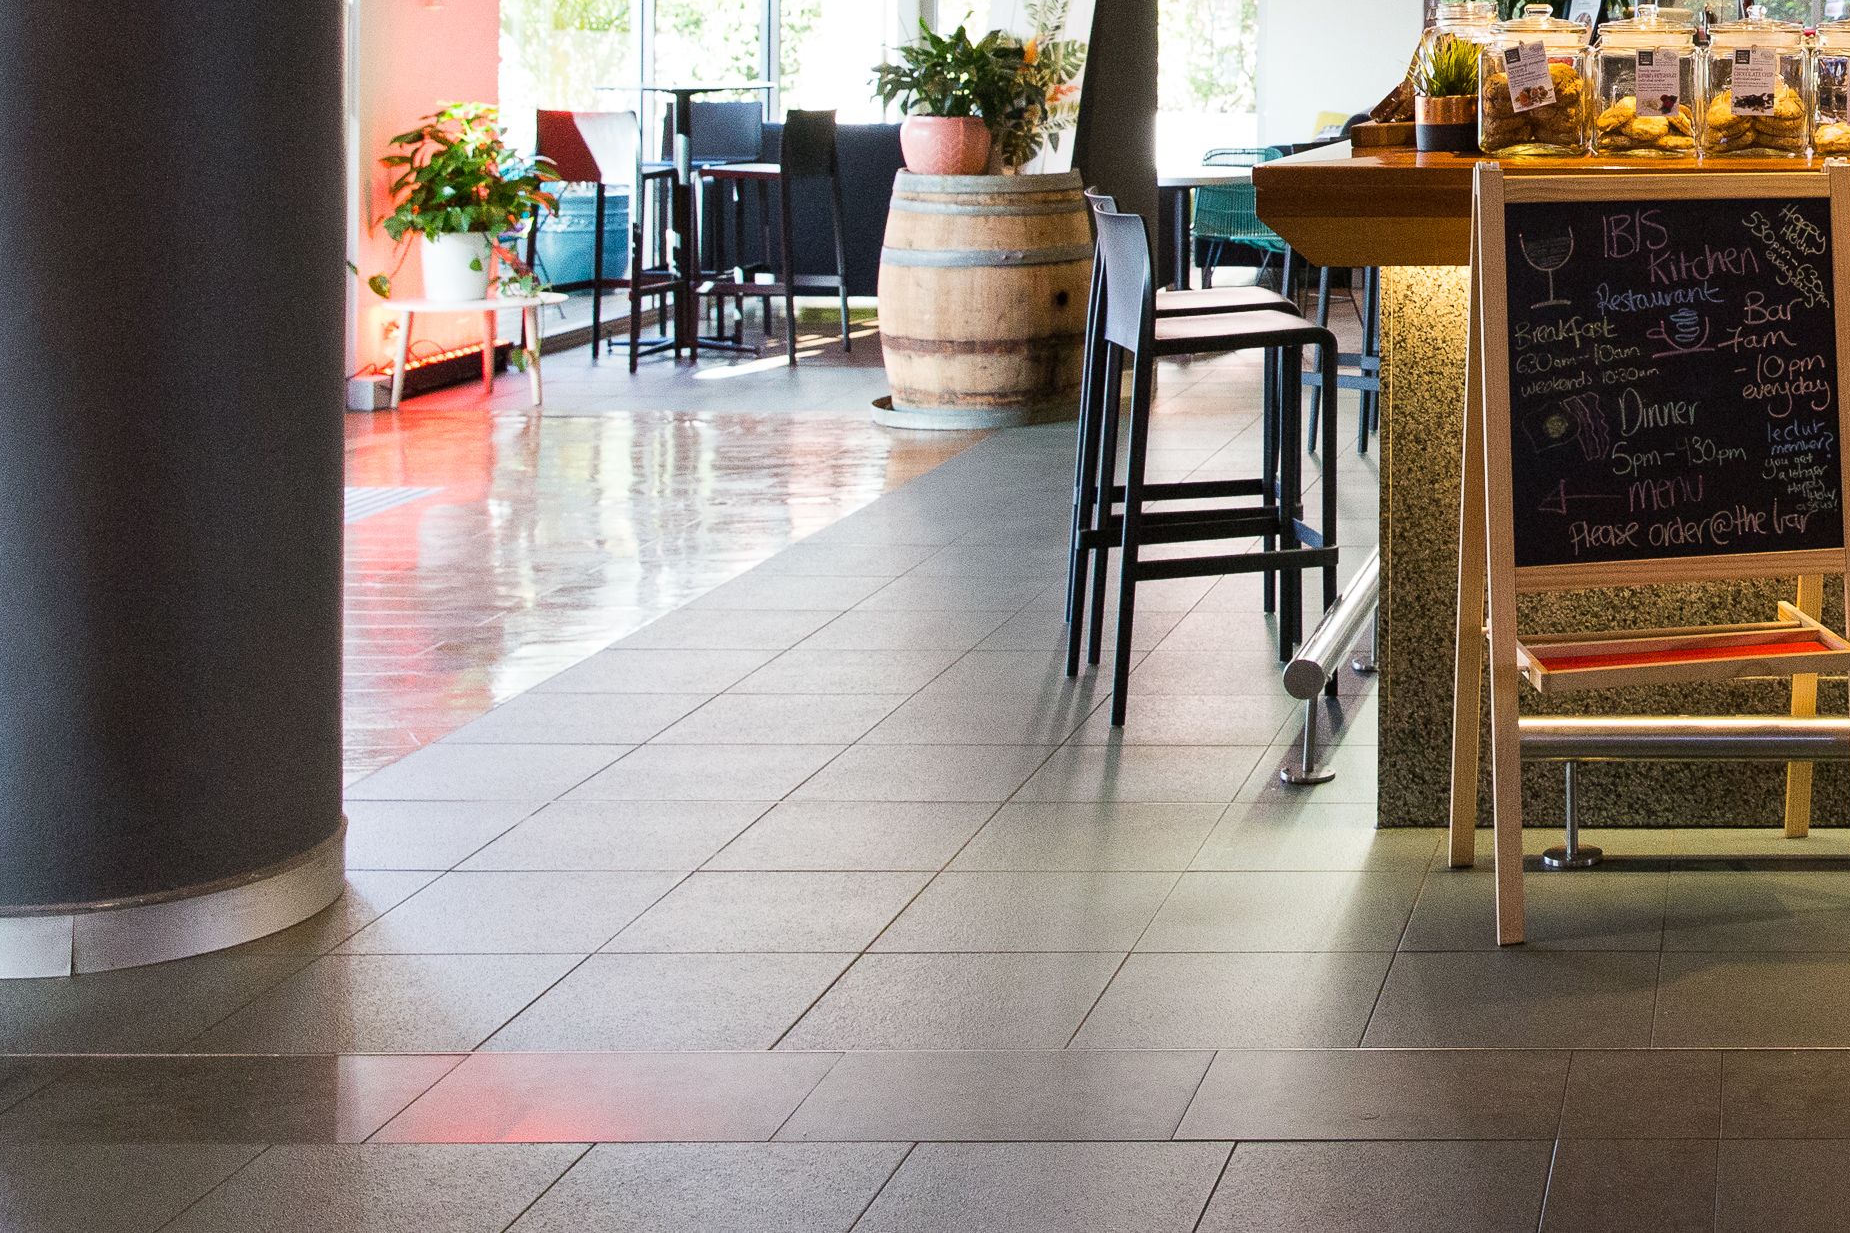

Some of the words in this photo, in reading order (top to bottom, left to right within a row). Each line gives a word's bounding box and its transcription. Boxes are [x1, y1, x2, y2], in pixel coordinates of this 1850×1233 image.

[1603, 209, 1668, 258] IBIS
[1778, 203, 1826, 255] Happy
[1780, 224, 1816, 256] Hour
[1649, 244, 1759, 285] Kitchen
[1597, 281, 1725, 315] Restaurant
[1743, 291, 1804, 324] Bar
[1514, 316, 1618, 350] Breakfast
[1718, 326, 1797, 353] 7am
[1521, 370, 1592, 398] weekends
[1742, 376, 1831, 418] everyday
[1618, 387, 1698, 436] Dinner
[1771, 431, 1834, 458] member?
[1762, 458, 1789, 479] you
[1794, 452, 1814, 476] get
[1778, 471, 1788, 482] a
[1789, 465, 1829, 482] longer
[1568, 520, 1639, 556] Please
[1774, 498, 1819, 535] bar
